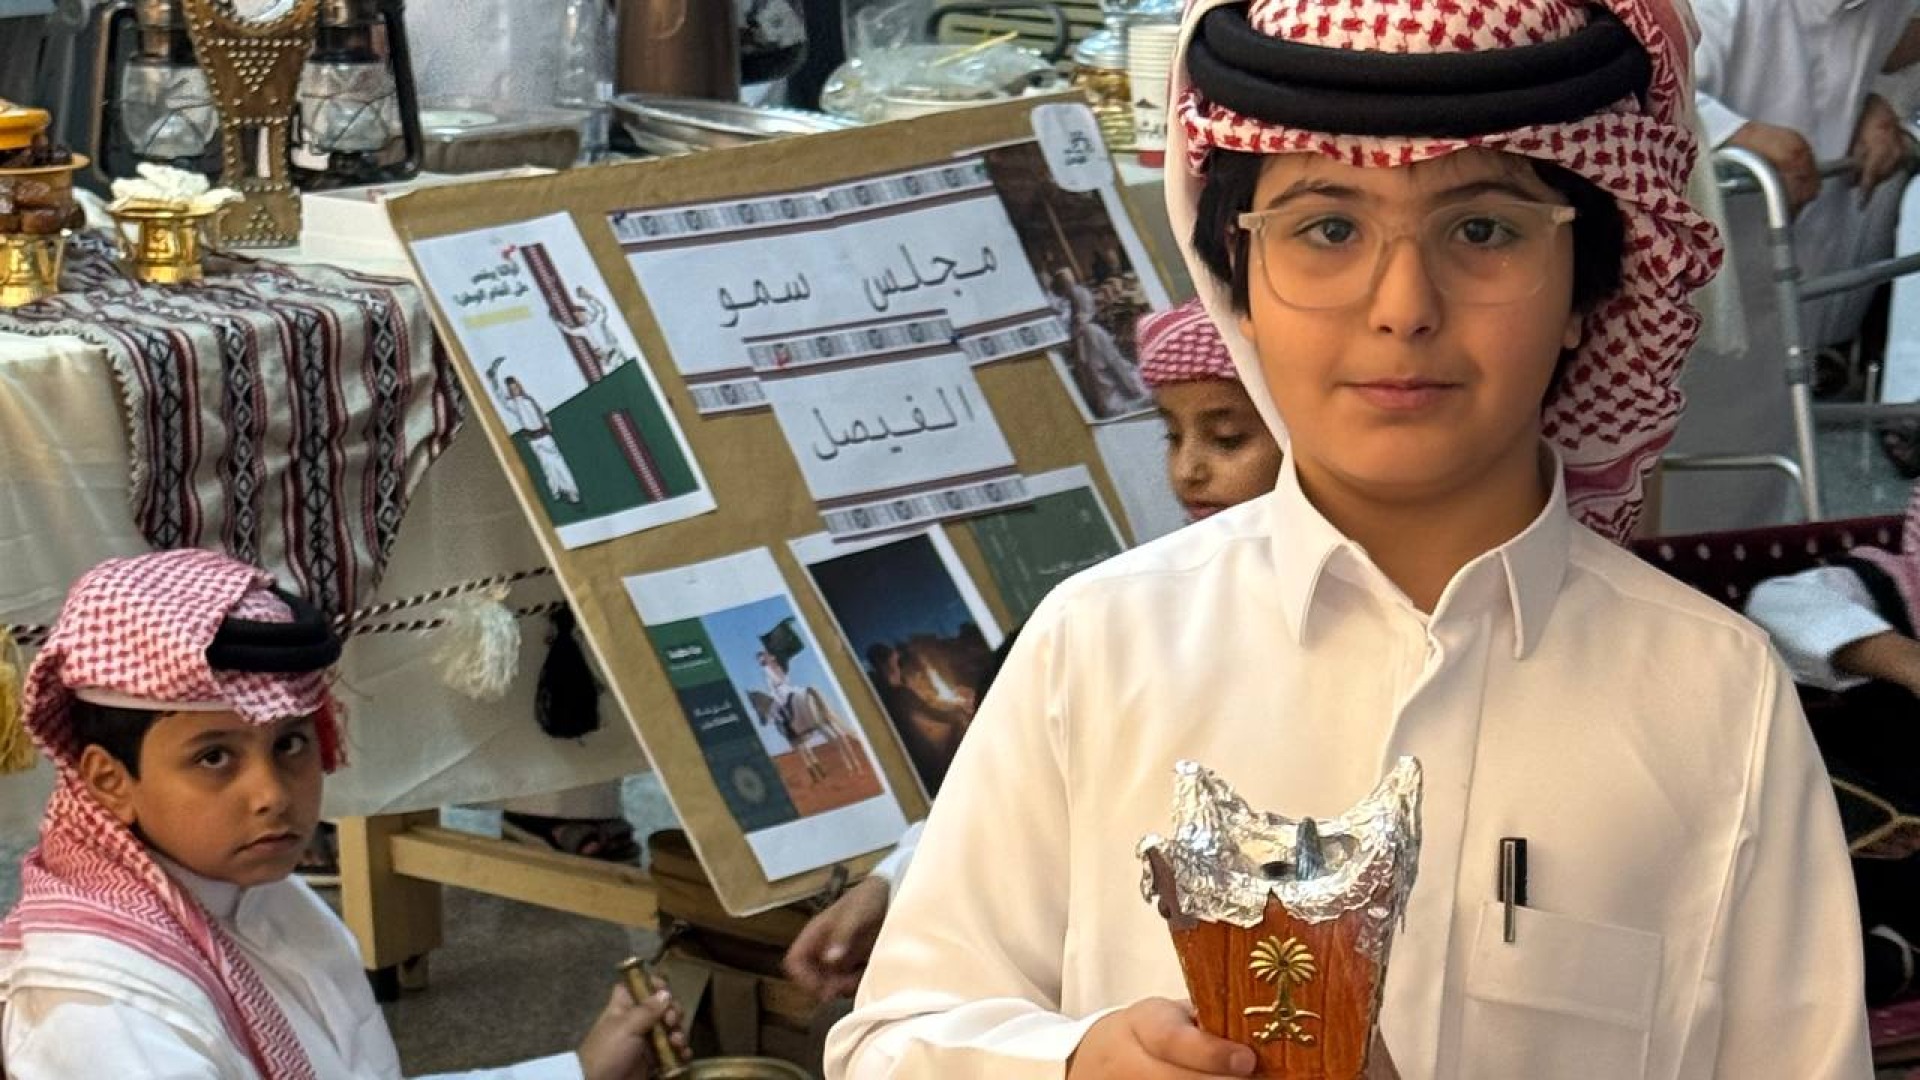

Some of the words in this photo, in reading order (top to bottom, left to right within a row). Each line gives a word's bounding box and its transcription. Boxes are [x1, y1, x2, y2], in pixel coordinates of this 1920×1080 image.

[719, 272, 810, 328] سمو
[863, 244, 997, 312] مجلس
[812, 385, 976, 460] الفيصل
